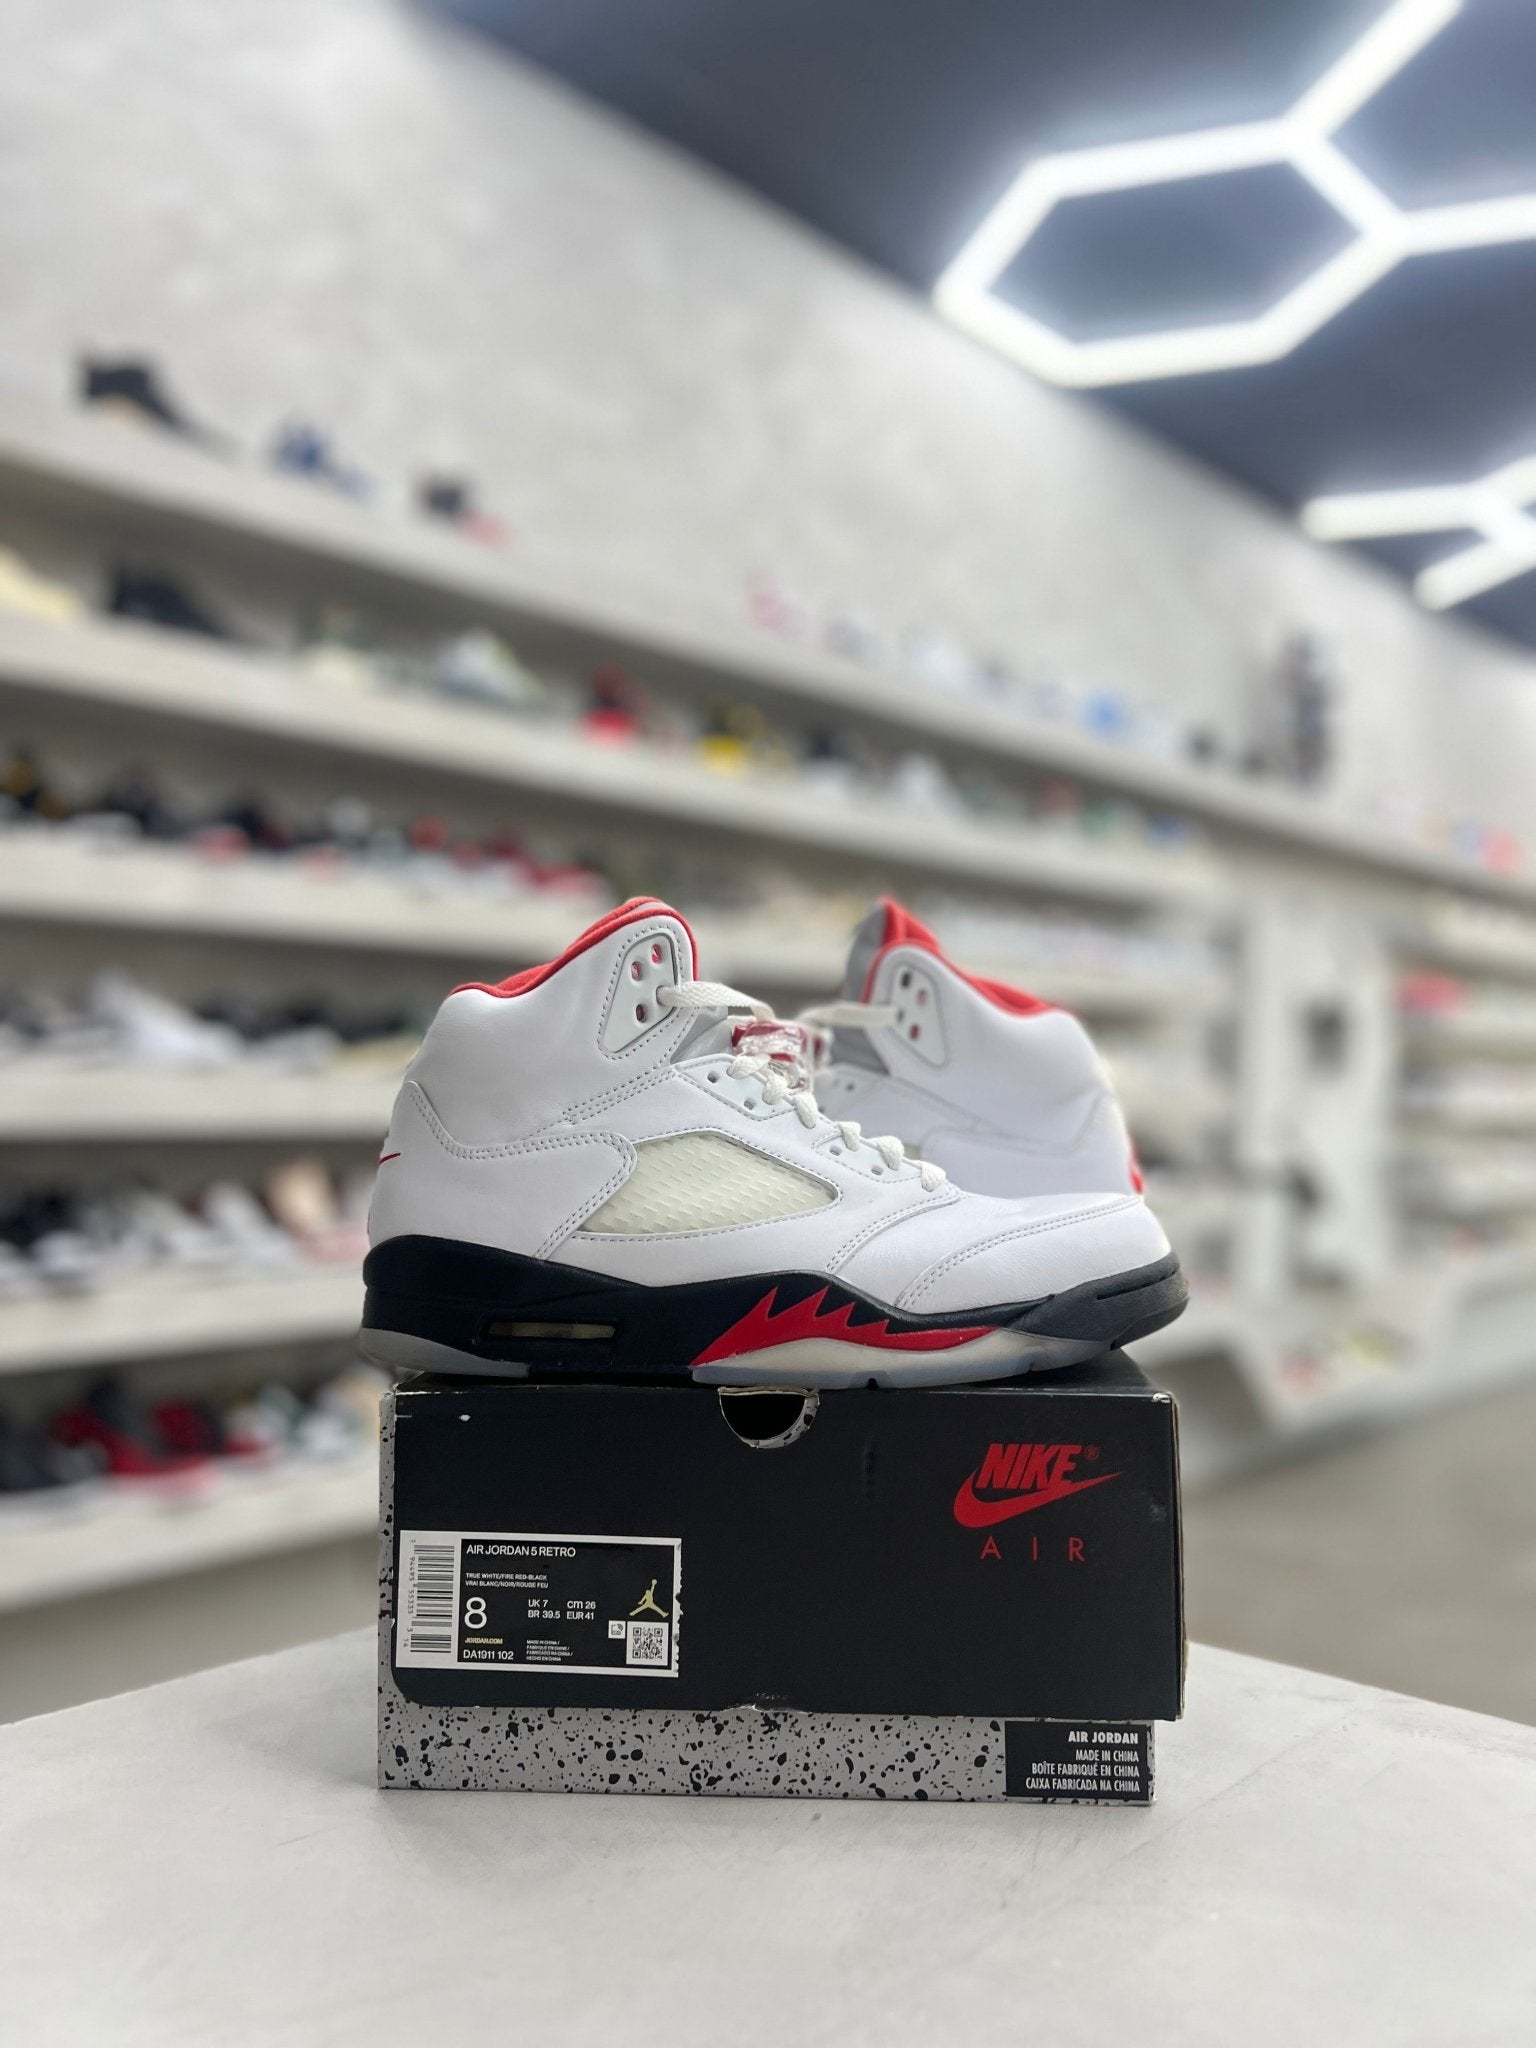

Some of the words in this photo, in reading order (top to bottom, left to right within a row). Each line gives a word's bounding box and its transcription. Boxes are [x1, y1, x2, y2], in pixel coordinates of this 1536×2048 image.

[975, 1443, 1082, 1489] NIKE
[466, 1544, 484, 1555] AIR
[485, 1545, 530, 1556] JORDAN
[531, 1546, 538, 1556] 5
[539, 1546, 577, 1558] RETRO
[980, 1535, 1086, 1562] AIR
[528, 1598, 540, 1608] UK
[542, 1599, 549, 1608] 7
[566, 1600, 584, 1609] cm
[585, 1601, 597, 1610] 26
[464, 1596, 488, 1629] 8
[527, 1609, 540, 1618] BR
[542, 1610, 561, 1619] 39.5
[566, 1611, 584, 1620] EUR
[585, 1612, 594, 1620] 41
[464, 1637, 504, 1645] JORDAN.COM
[463, 1649, 495, 1659] DA1911
[498, 1650, 514, 1660] 102
[1068, 1731, 1089, 1743] AIR
[1092, 1732, 1139, 1744] JORDAN
[1075, 1749, 1100, 1762] MADE
[1102, 1750, 1111, 1762] IN
[1113, 1750, 1140, 1763] CHINA
[1031, 1760, 1056, 1775] BOÎTE
[1057, 1762, 1098, 1777] FABRIQUÉ
[1100, 1764, 1112, 1777] EN
[1113, 1765, 1140, 1778] CHINA
[1025, 1777, 1051, 1790] CAIXA
[1052, 1778, 1098, 1791] FABRICADA
[1100, 1779, 1112, 1792] NA
[1113, 1780, 1141, 1793] CHINA
